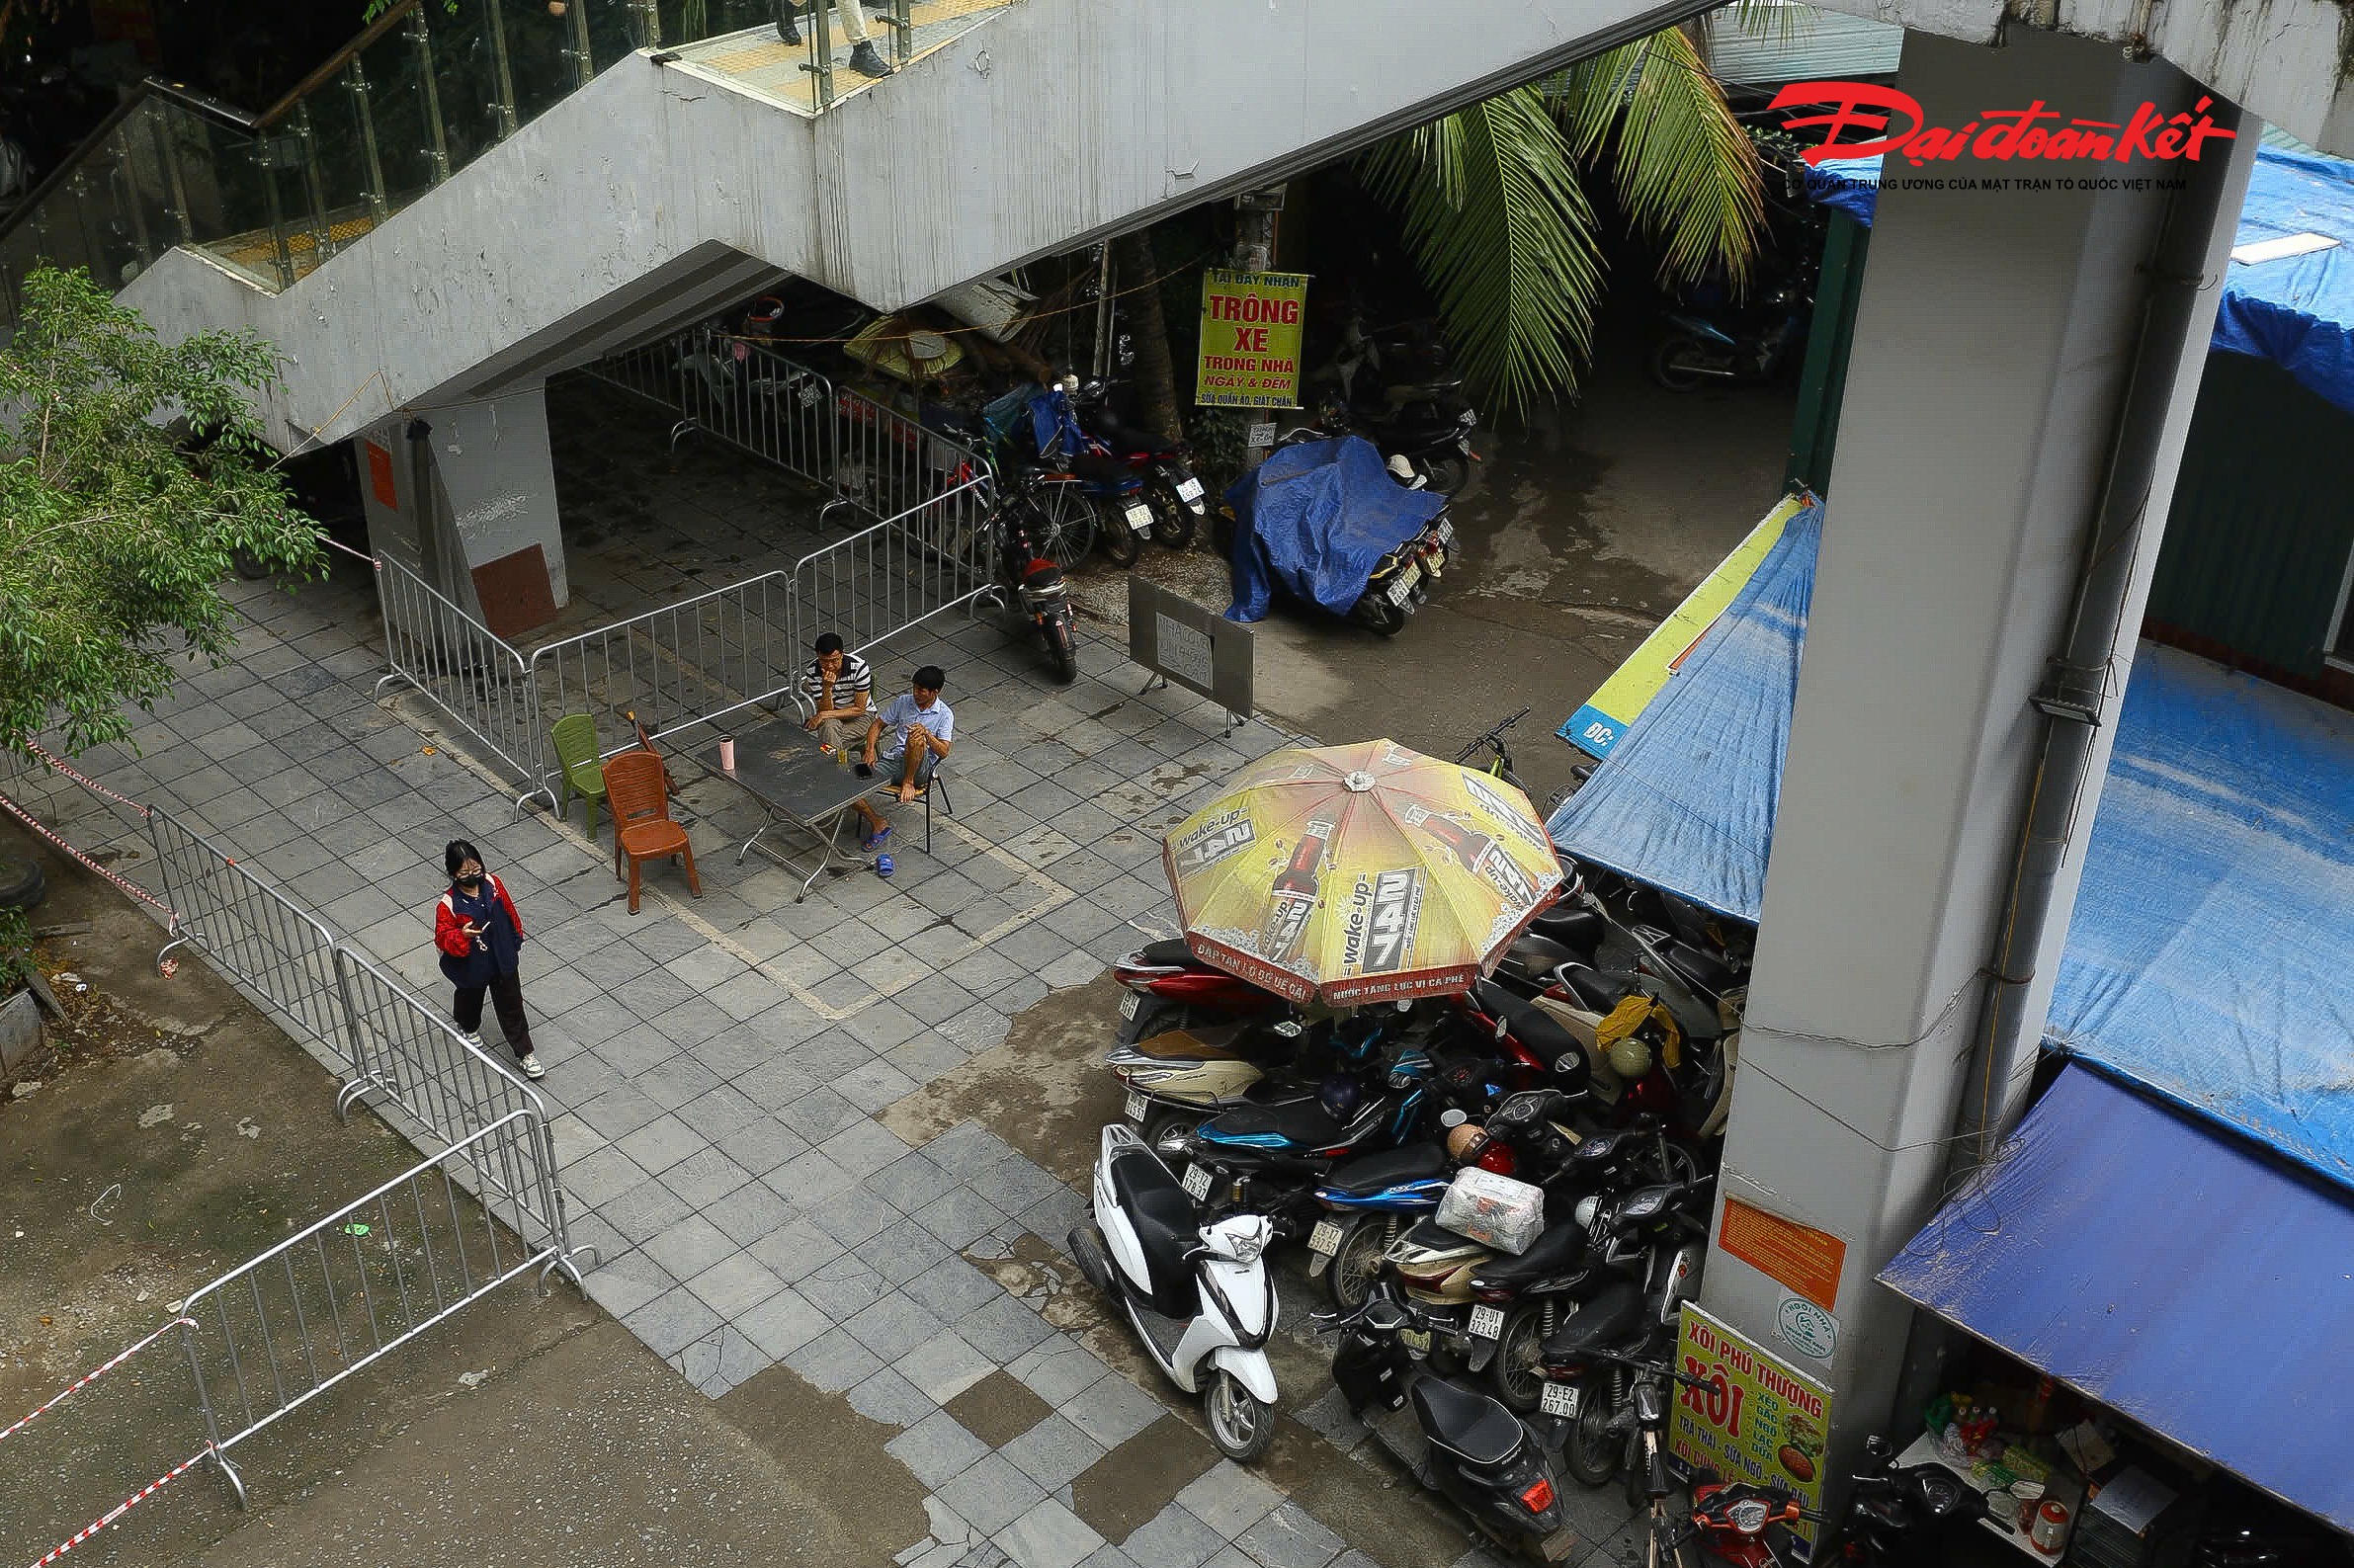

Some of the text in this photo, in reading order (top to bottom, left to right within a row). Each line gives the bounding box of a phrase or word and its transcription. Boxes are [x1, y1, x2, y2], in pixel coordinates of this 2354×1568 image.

[1209, 292, 1299, 324] TRÔNG
[1234, 327, 1269, 352] XE
[1204, 356, 1294, 373] TRONG NHÀ
[1204, 374, 1293, 389] NGÀY & ĐÊM
[1470, 1319, 1499, 1338] 323.48
[1688, 1320, 1717, 1355] XÔI
[1720, 1339, 1754, 1375] PHÚ
[1756, 1362, 1823, 1420] THƯỢNG
[1547, 1384, 1574, 1402] 29-E2
[1680, 1354, 1744, 1439] XÔI
[1543, 1397, 1575, 1416] 267.00
